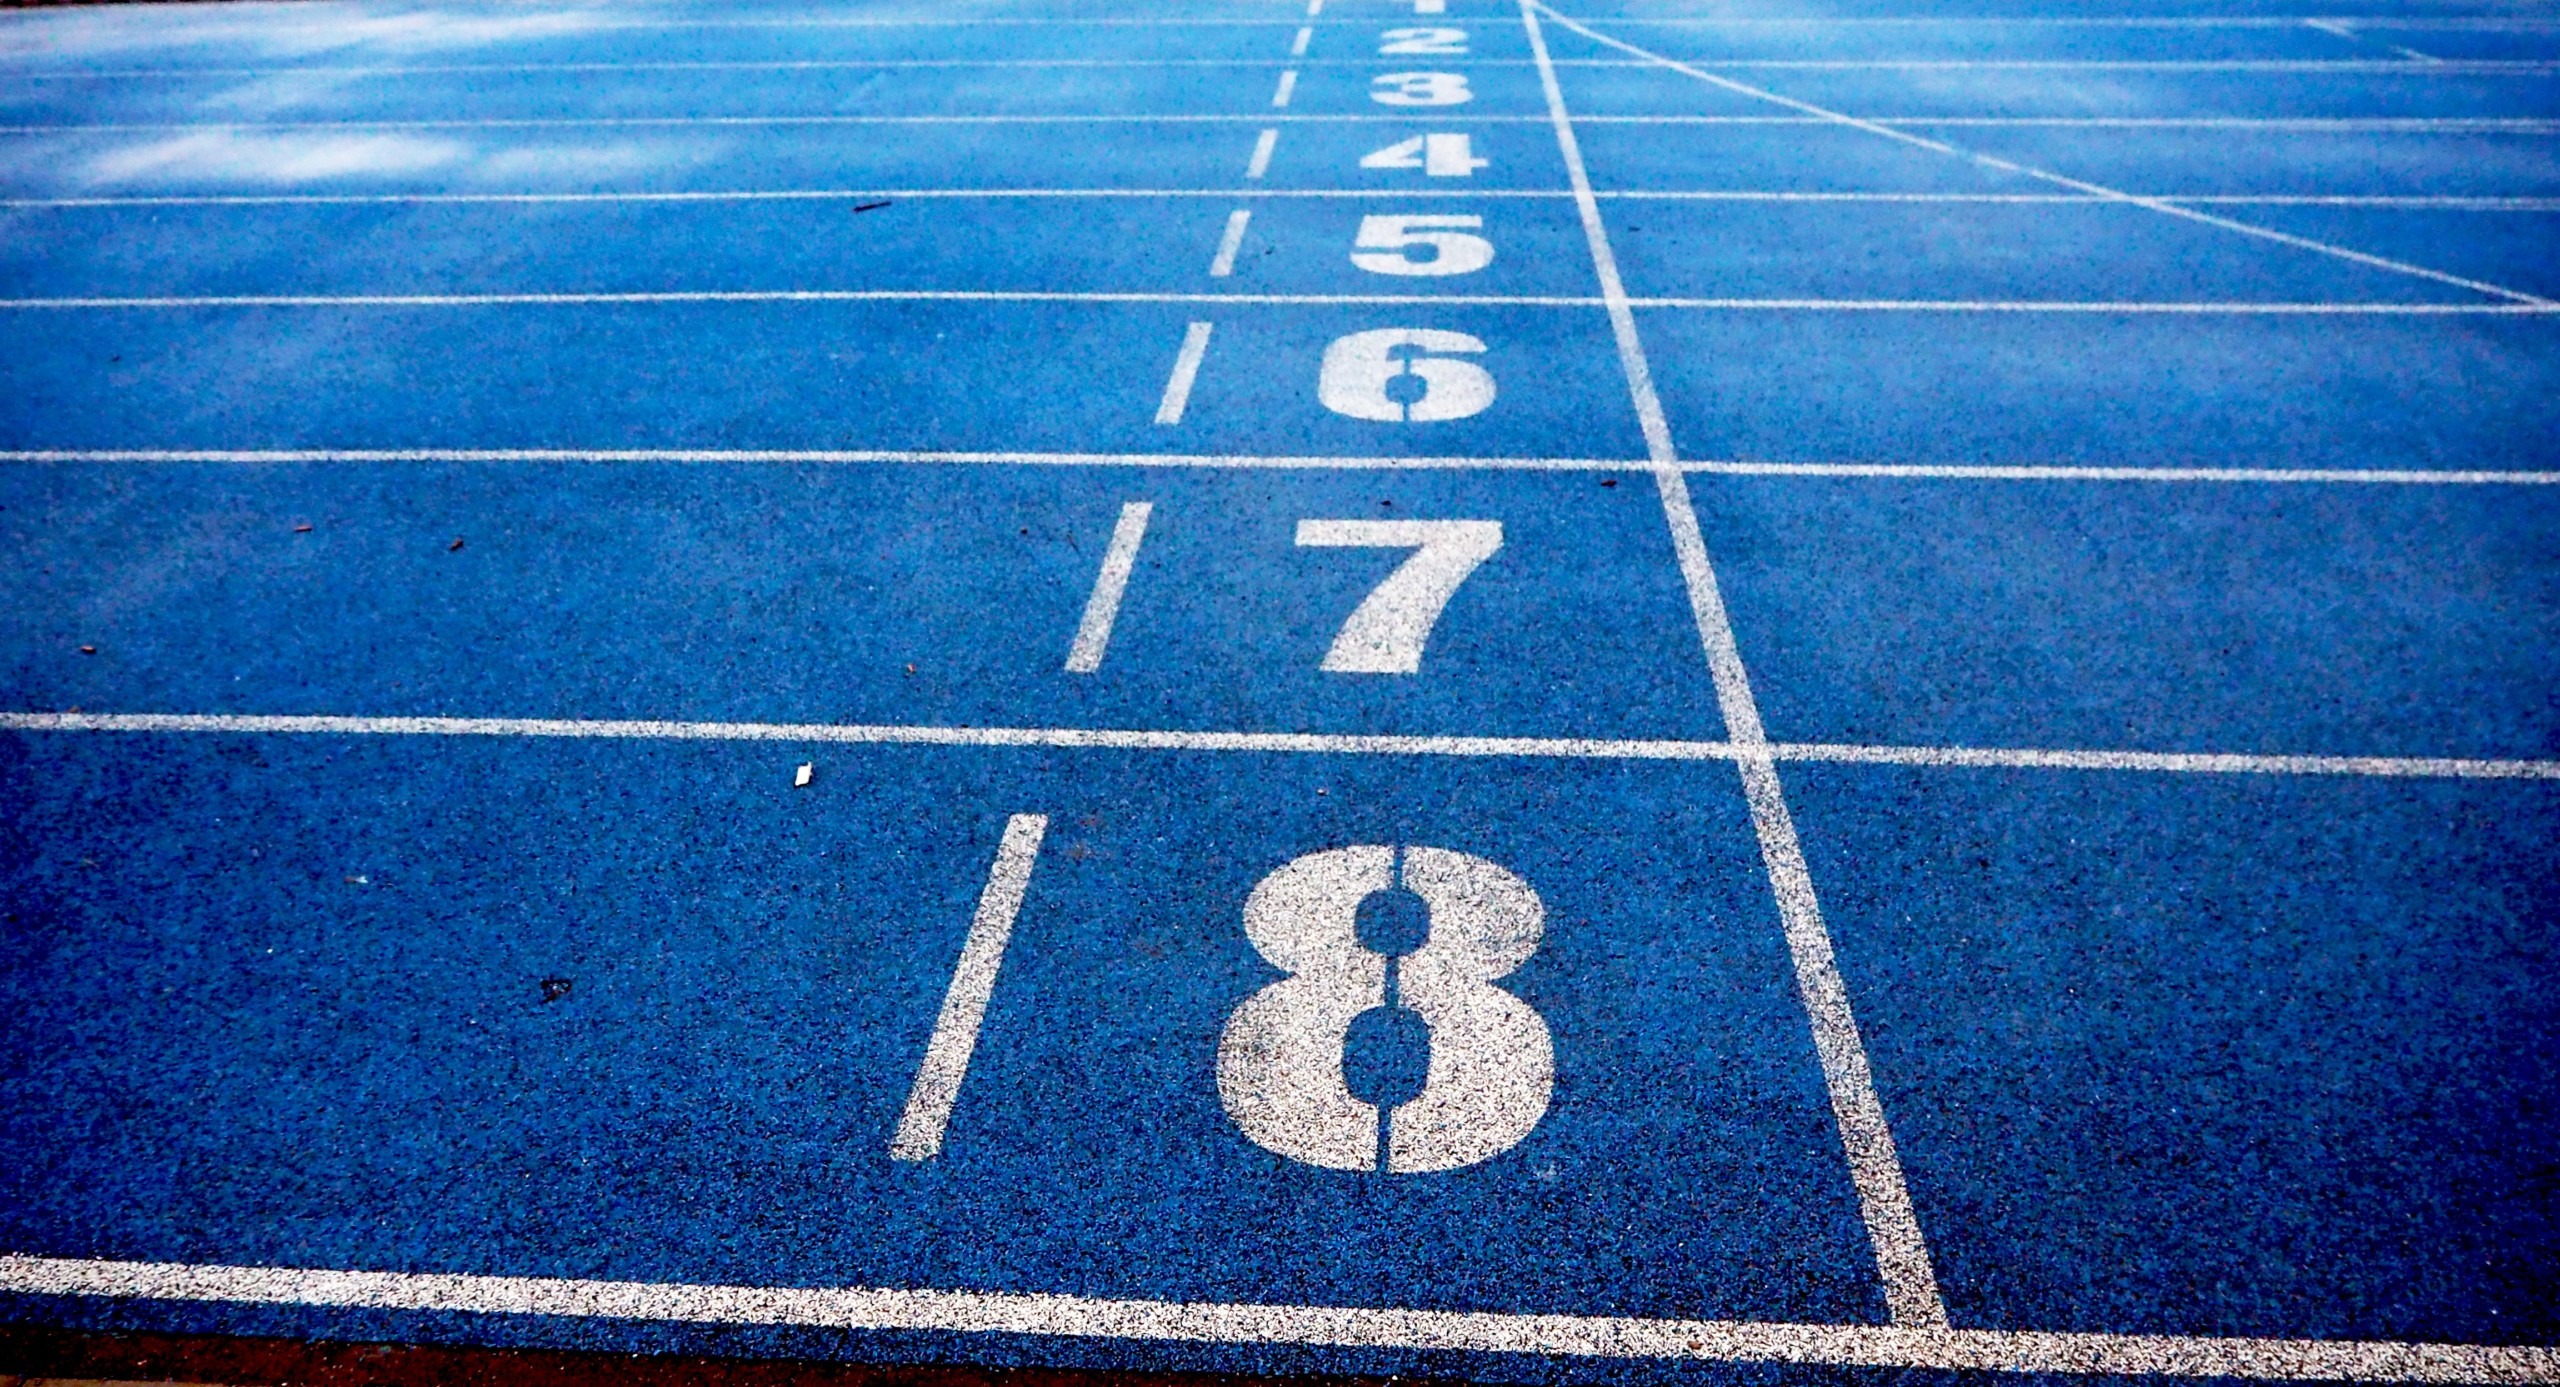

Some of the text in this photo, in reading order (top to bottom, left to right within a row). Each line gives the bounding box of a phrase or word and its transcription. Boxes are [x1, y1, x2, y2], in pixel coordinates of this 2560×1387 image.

[1378, 27, 1470, 54] 2
[1370, 71, 1474, 106] 3
[1359, 133, 1489, 176] 4
[1350, 215, 1495, 276] 5
[1317, 328, 1496, 423] 6
[1294, 519, 1504, 674] 7
[1216, 844, 1555, 1175] 8
